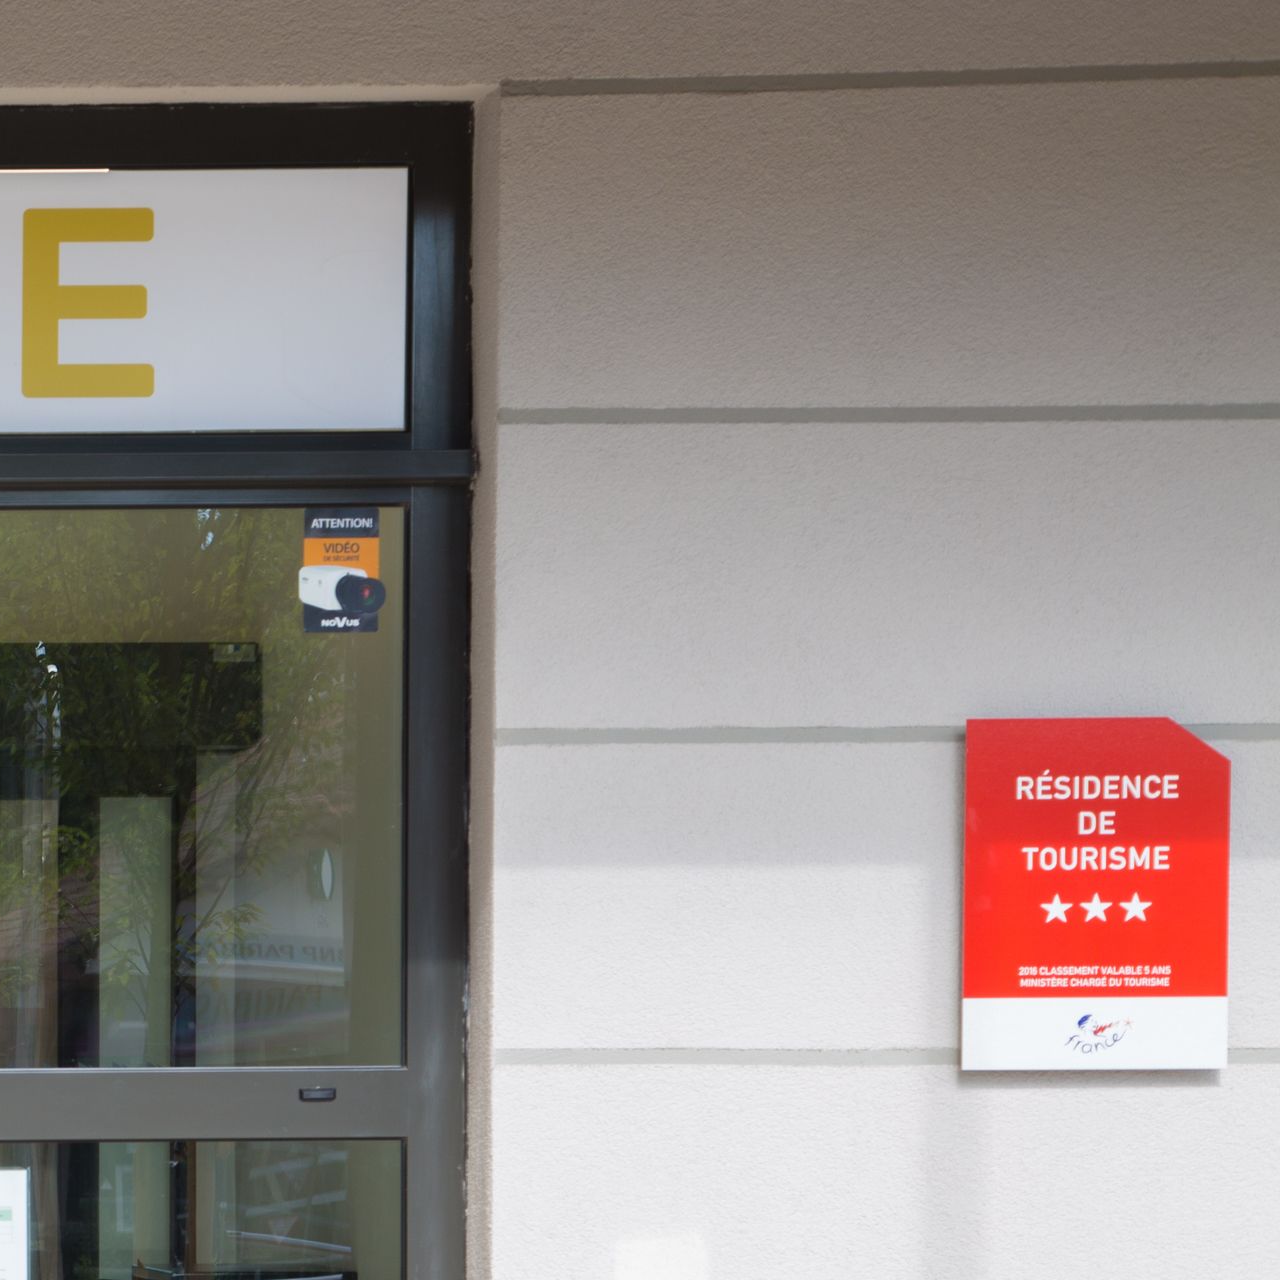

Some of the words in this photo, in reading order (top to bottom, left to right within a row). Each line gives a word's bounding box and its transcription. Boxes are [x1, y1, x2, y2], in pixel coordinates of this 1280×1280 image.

[311, 517, 373, 529] ATTENTION!
[323, 541, 360, 553] VIDÉO
[1015, 769, 1180, 800] RÉSIDENCE
[1078, 811, 1116, 835] DE
[1021, 846, 1171, 871] TOURISME
[1039, 966, 1099, 977] CLASSEMENT
[1101, 966, 1141, 976] VALABLE
[1151, 965, 1172, 976] ANS
[1109, 977, 1123, 987] DU
[1124, 977, 1170, 988] TOURISME
